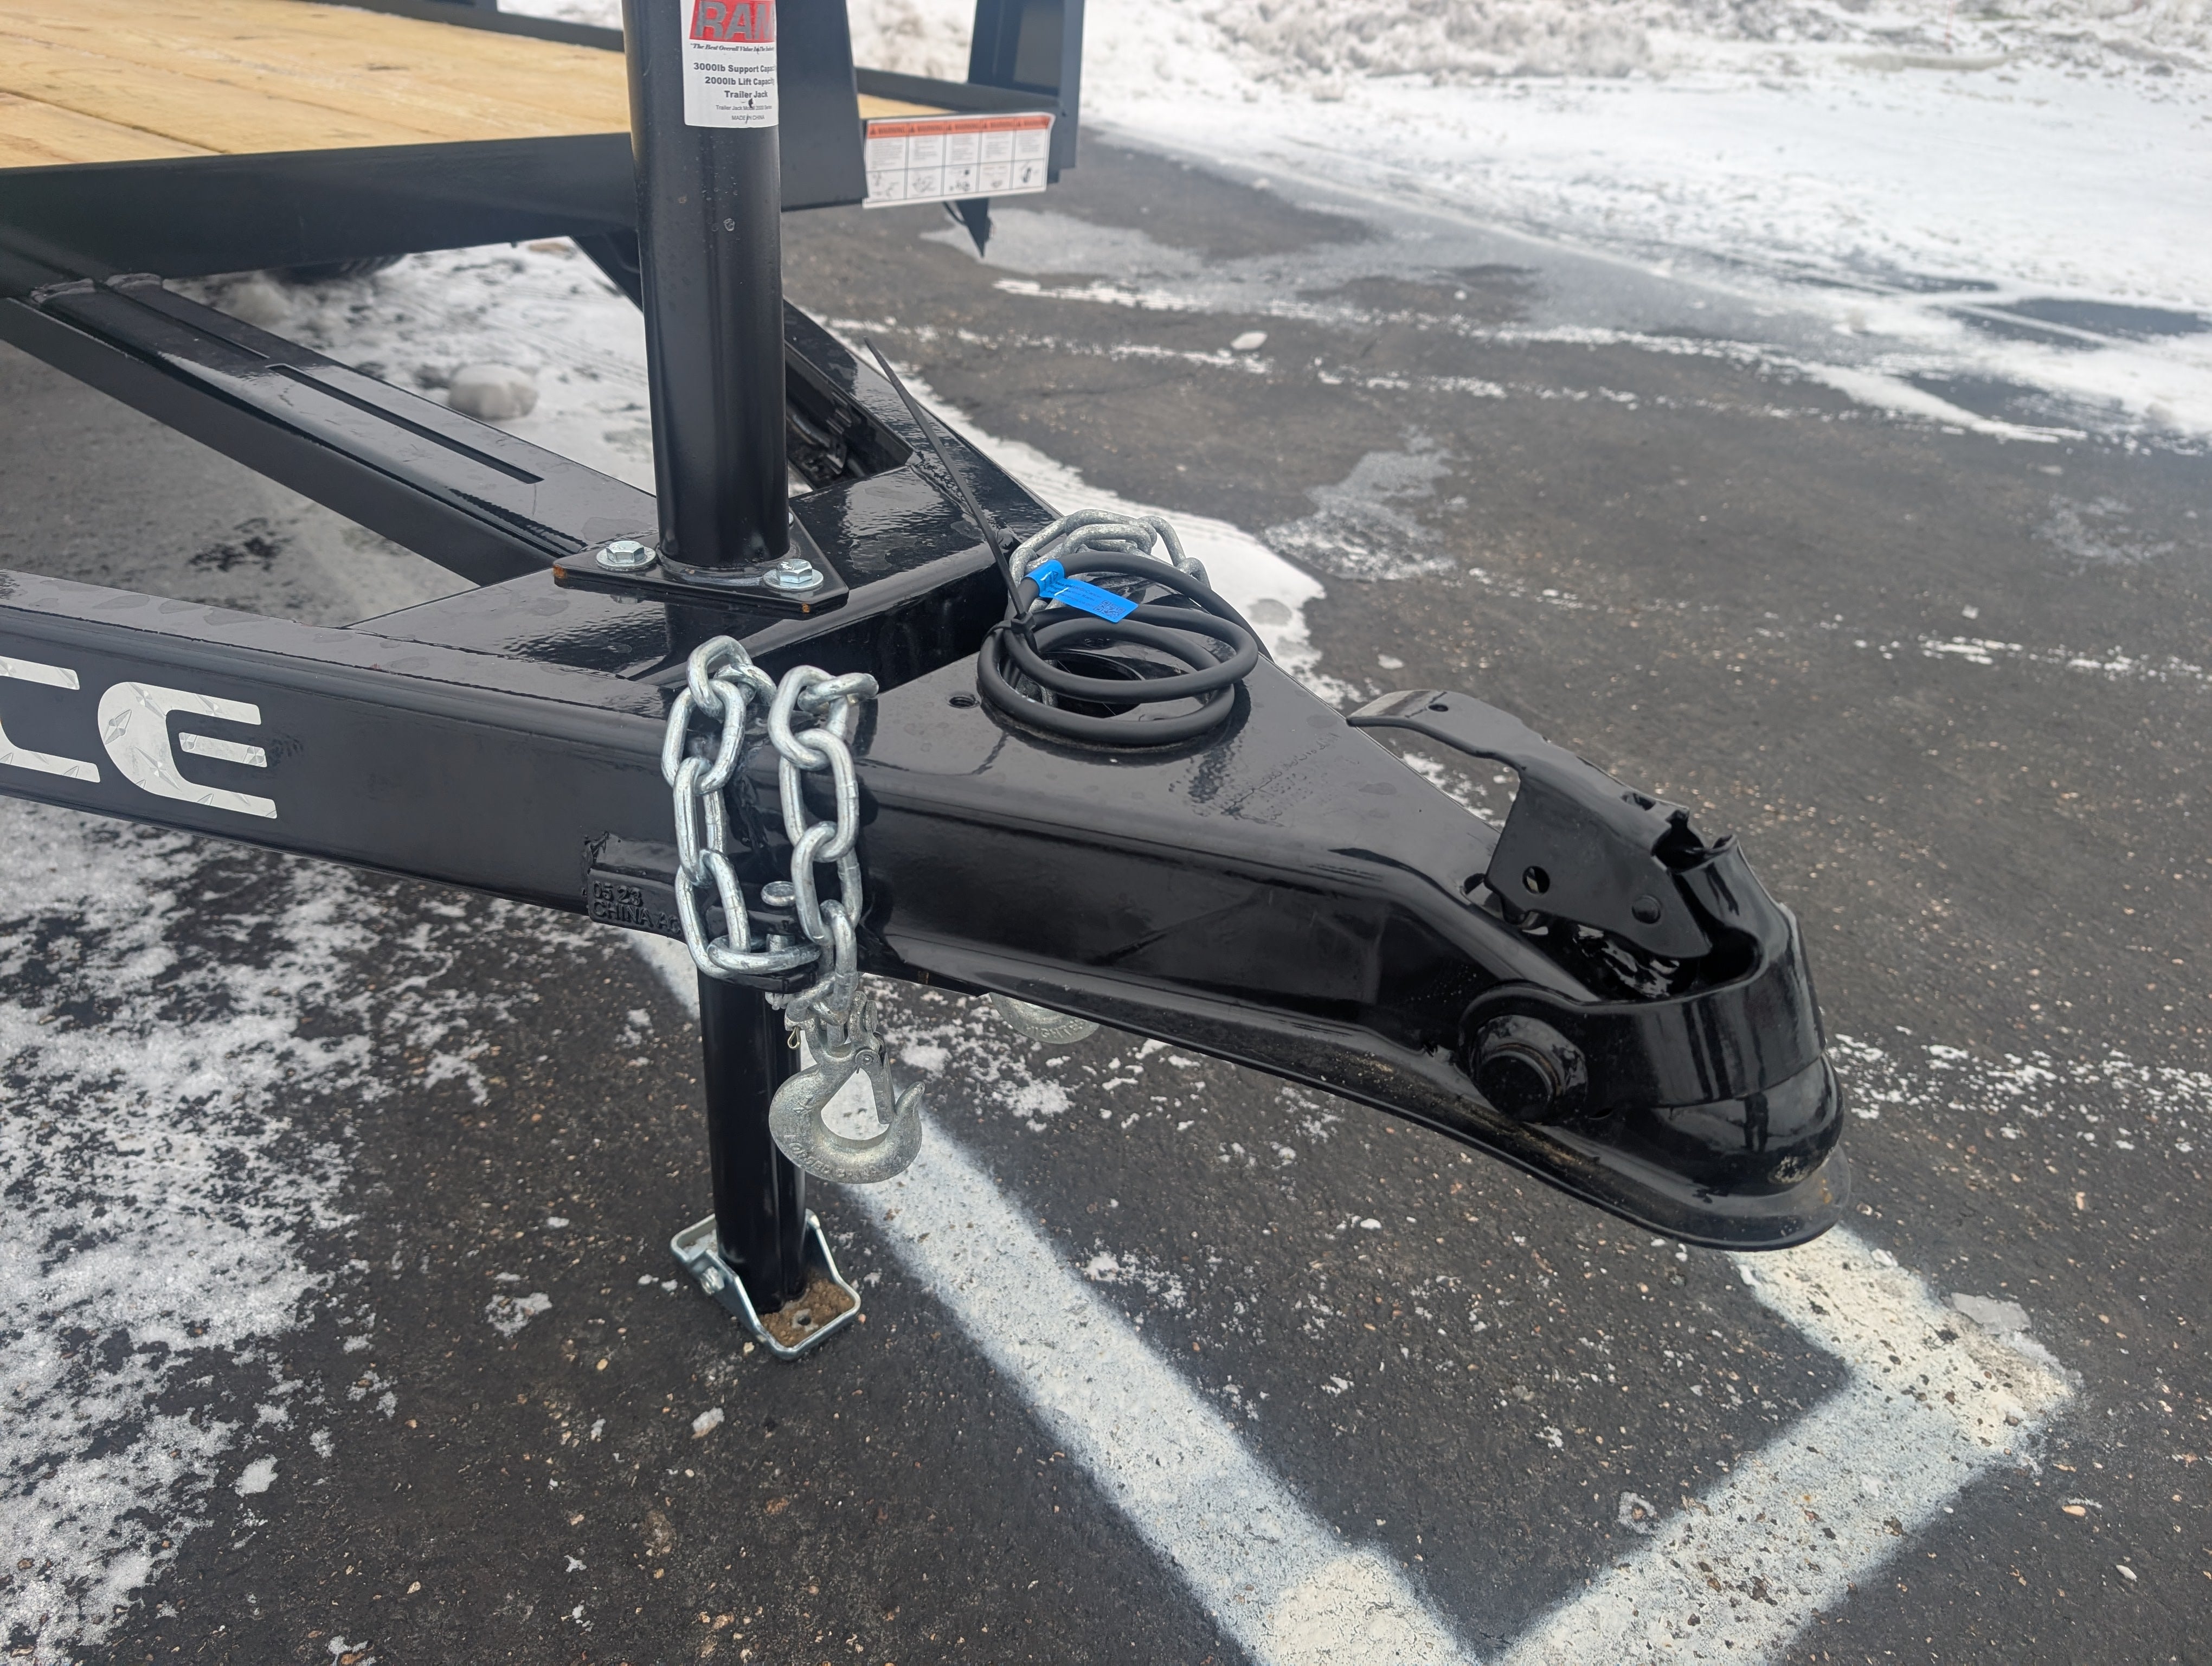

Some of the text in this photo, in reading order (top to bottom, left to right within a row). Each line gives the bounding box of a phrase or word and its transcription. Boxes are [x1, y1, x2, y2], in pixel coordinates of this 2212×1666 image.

[693, 62, 725, 72] 3000lb
[728, 65, 759, 74] Support
[705, 76, 736, 85] 2000lb
[593, 880, 644, 907] 05 23
[593, 901, 654, 928] CHINA
